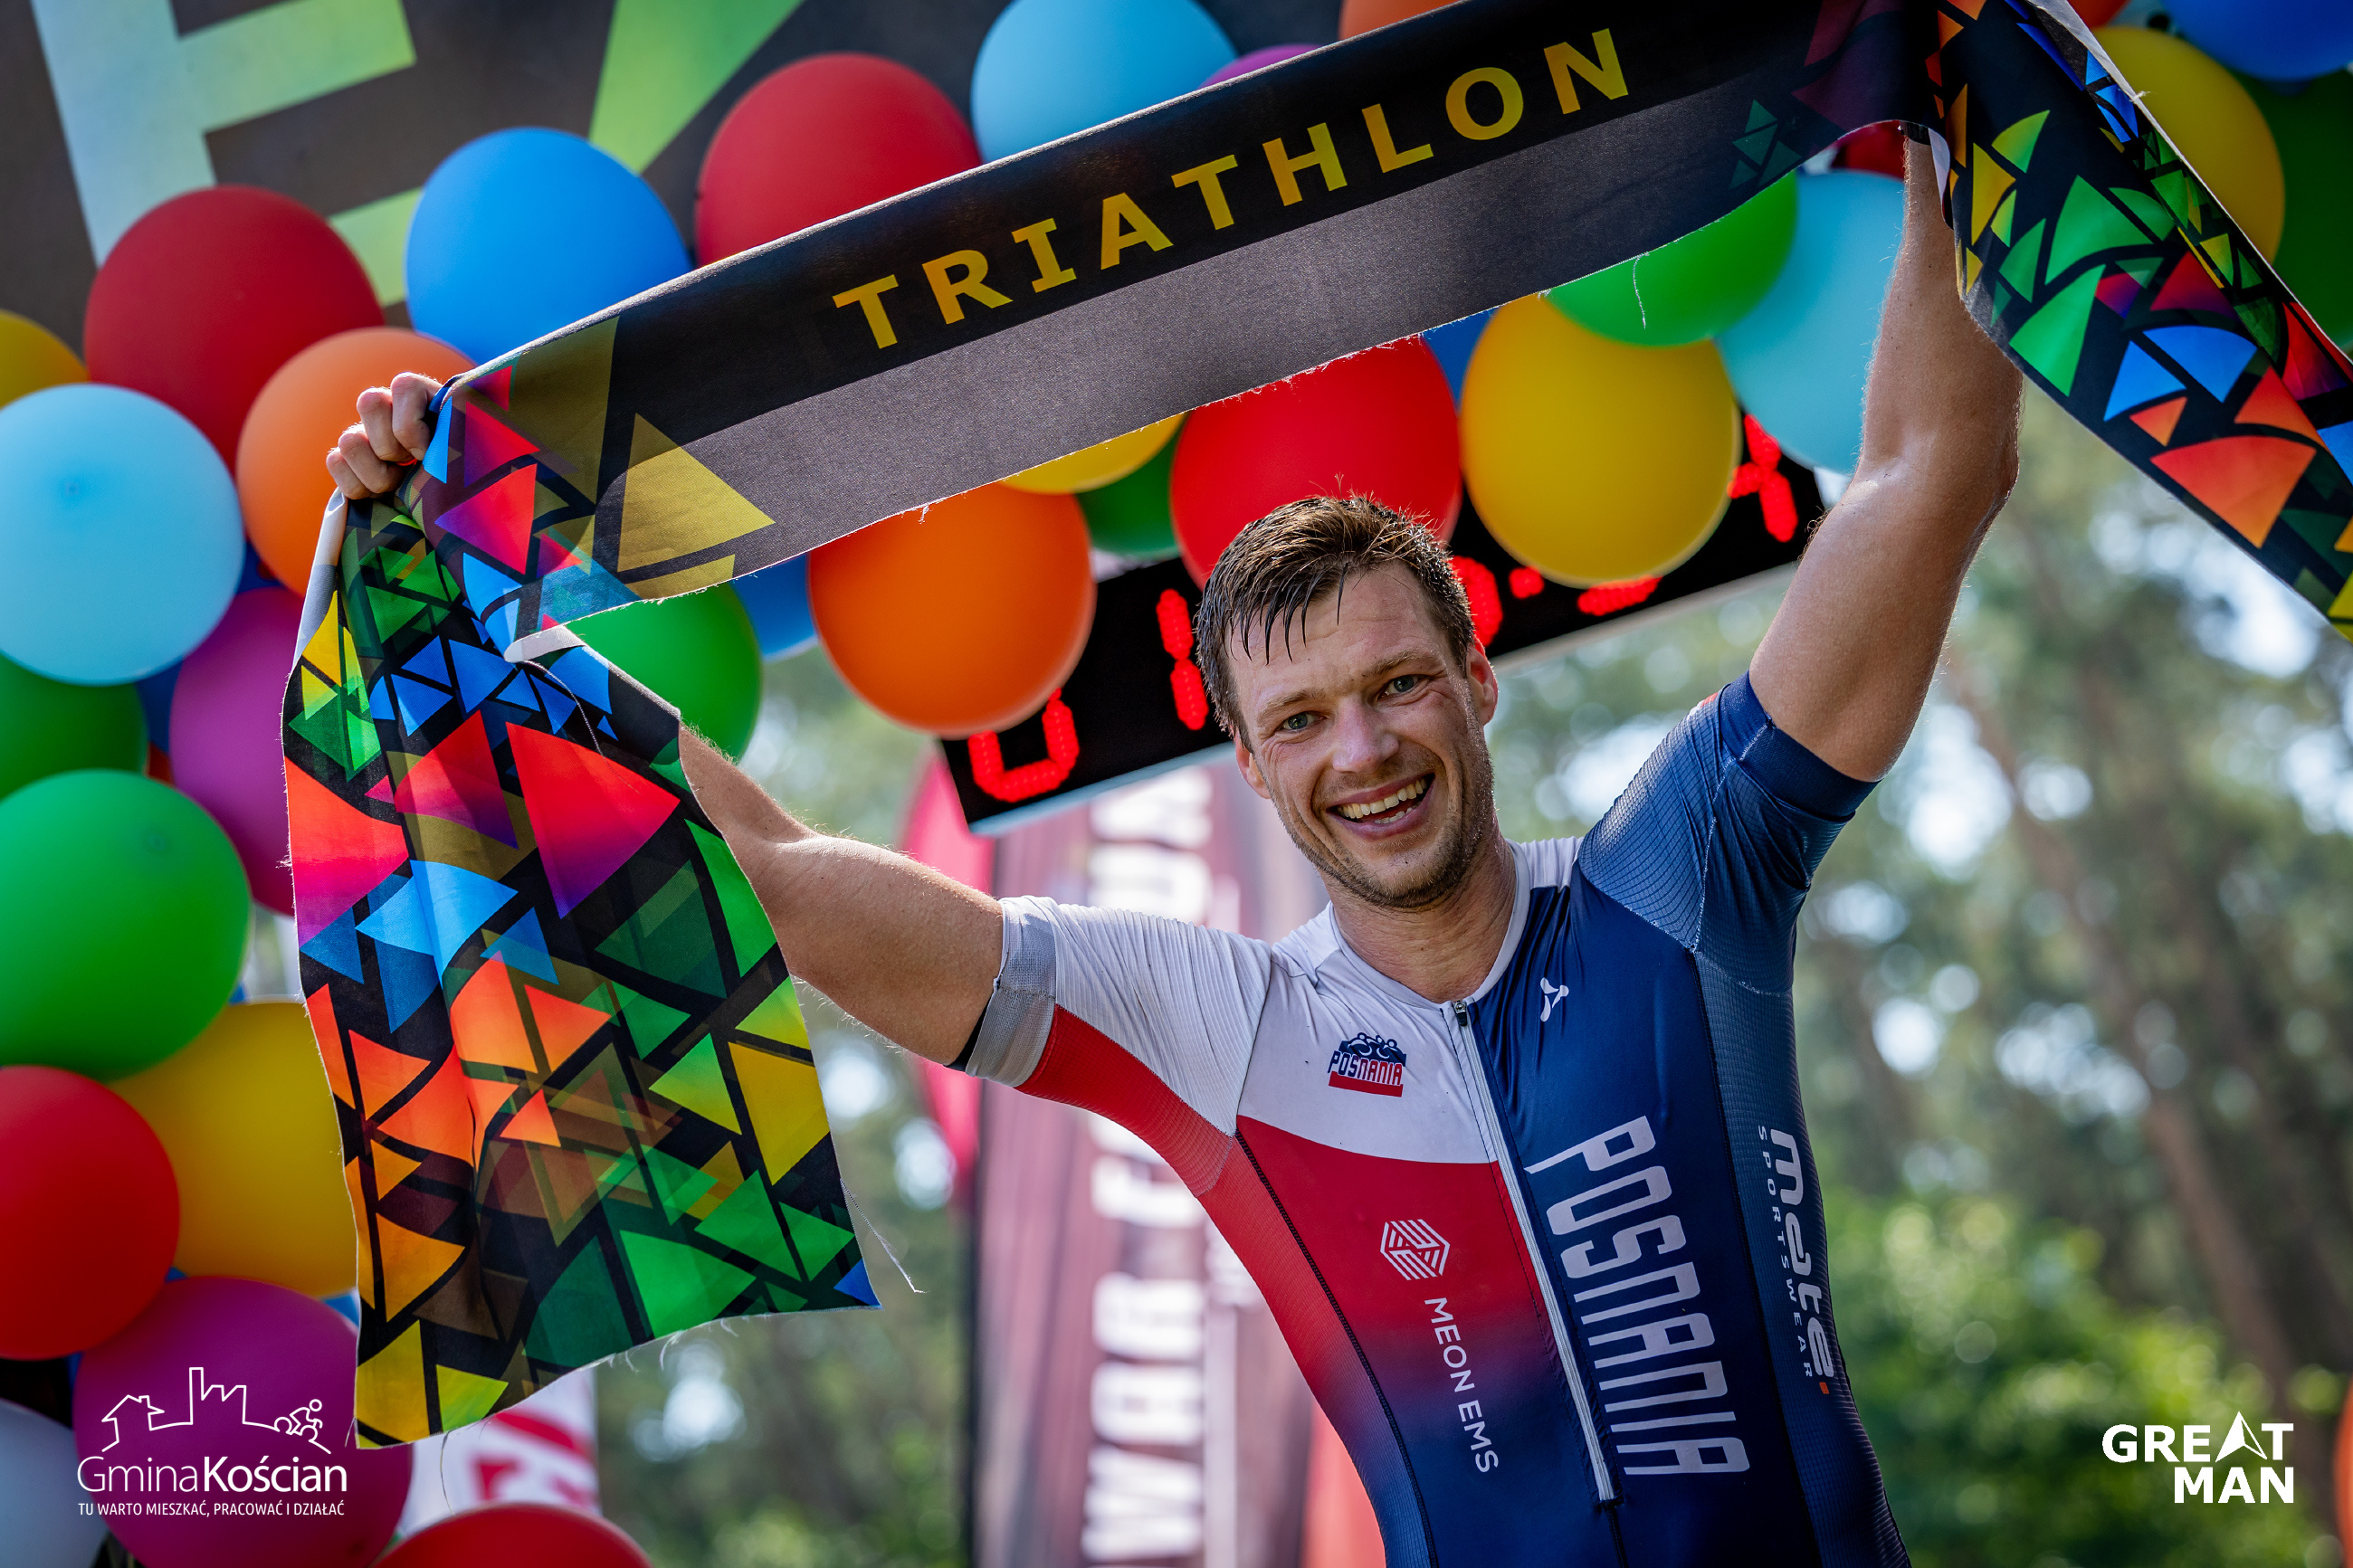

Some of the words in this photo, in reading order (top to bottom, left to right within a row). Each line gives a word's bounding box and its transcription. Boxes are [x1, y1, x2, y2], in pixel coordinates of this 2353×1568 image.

[833, 28, 1628, 349] TRIATHLON
[1328, 1050, 1403, 1086] POSNANIA
[1523, 1116, 1749, 1476] POSNANIA
[1758, 1125, 1813, 1377] SPORTSWEAR
[1424, 1297, 1475, 1392] MEON
[1458, 1400, 1499, 1473] EMS
